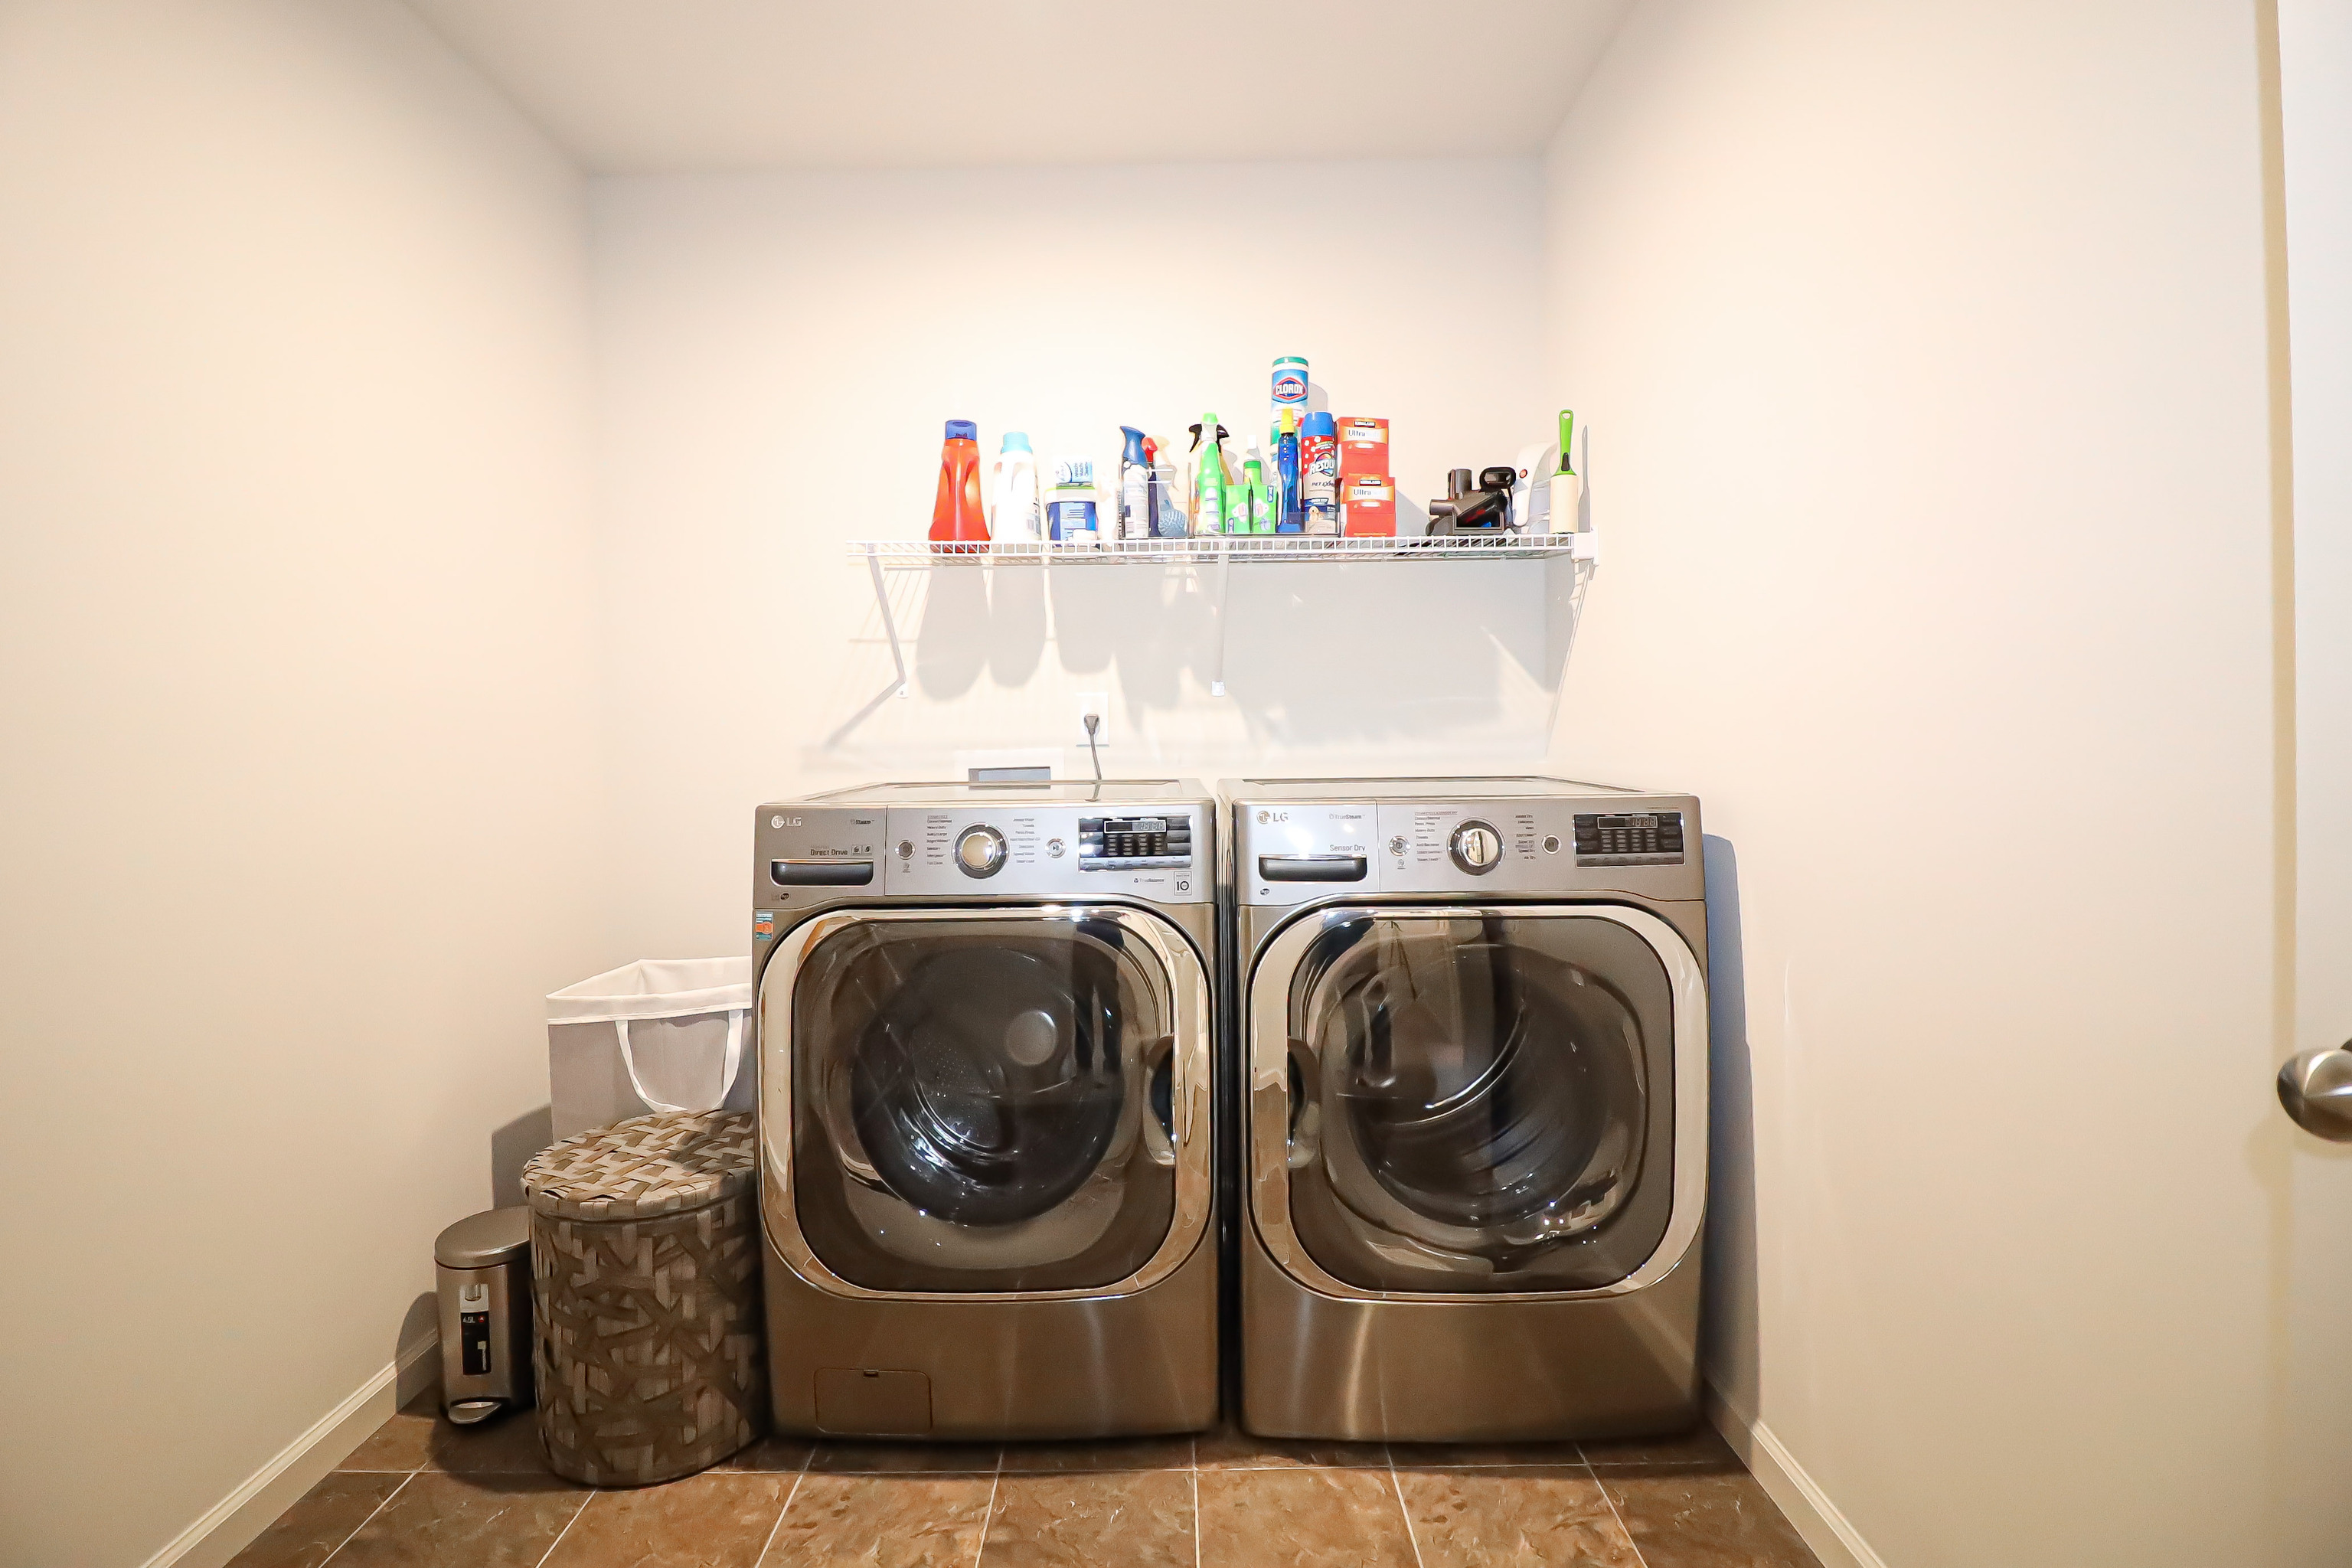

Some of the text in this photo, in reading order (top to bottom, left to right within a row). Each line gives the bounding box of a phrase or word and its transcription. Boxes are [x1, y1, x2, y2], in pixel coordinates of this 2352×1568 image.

[1275, 384, 1304, 395] CLOROX
[1348, 429, 1366, 437] Ultra
[786, 817, 802, 827] LG
[1272, 812, 1289, 822] LG
[1176, 880, 1190, 891] 10
